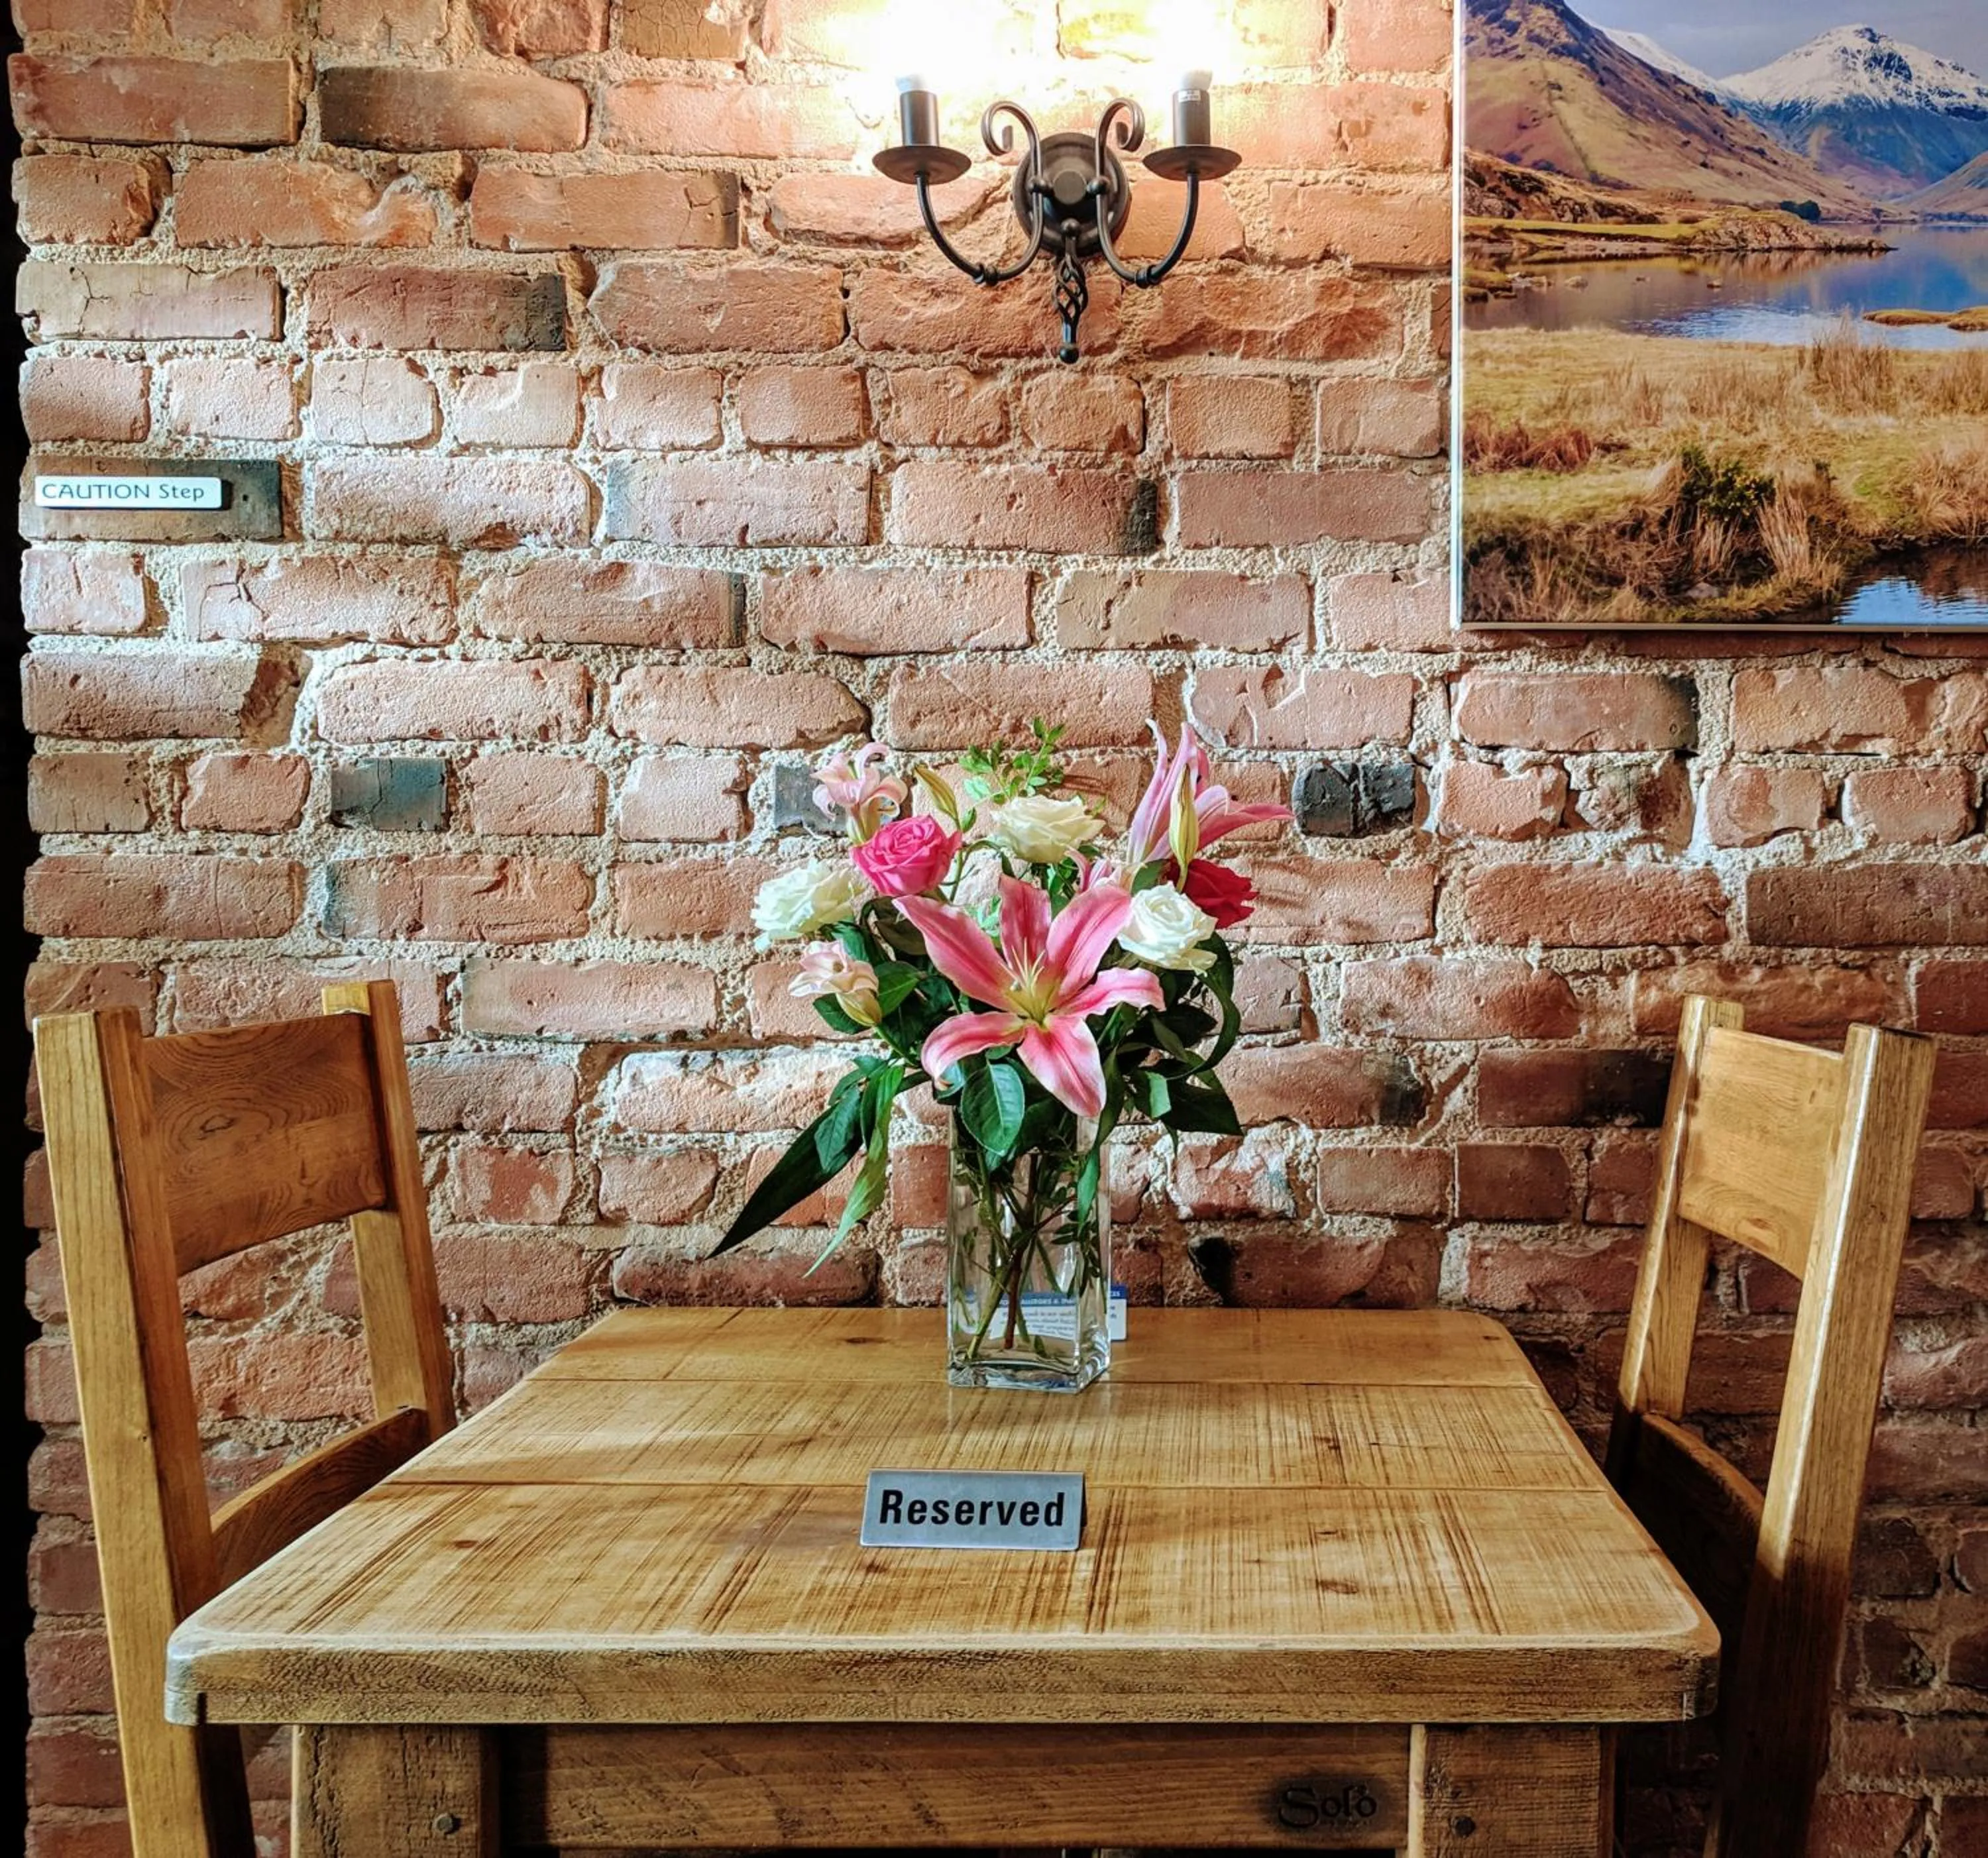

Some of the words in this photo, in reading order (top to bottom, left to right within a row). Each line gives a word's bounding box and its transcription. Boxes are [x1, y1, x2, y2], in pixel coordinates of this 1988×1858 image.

[42, 483, 150, 499] CAUTION
[158, 483, 205, 502] Step
[879, 1489, 1065, 1527] Reserved
